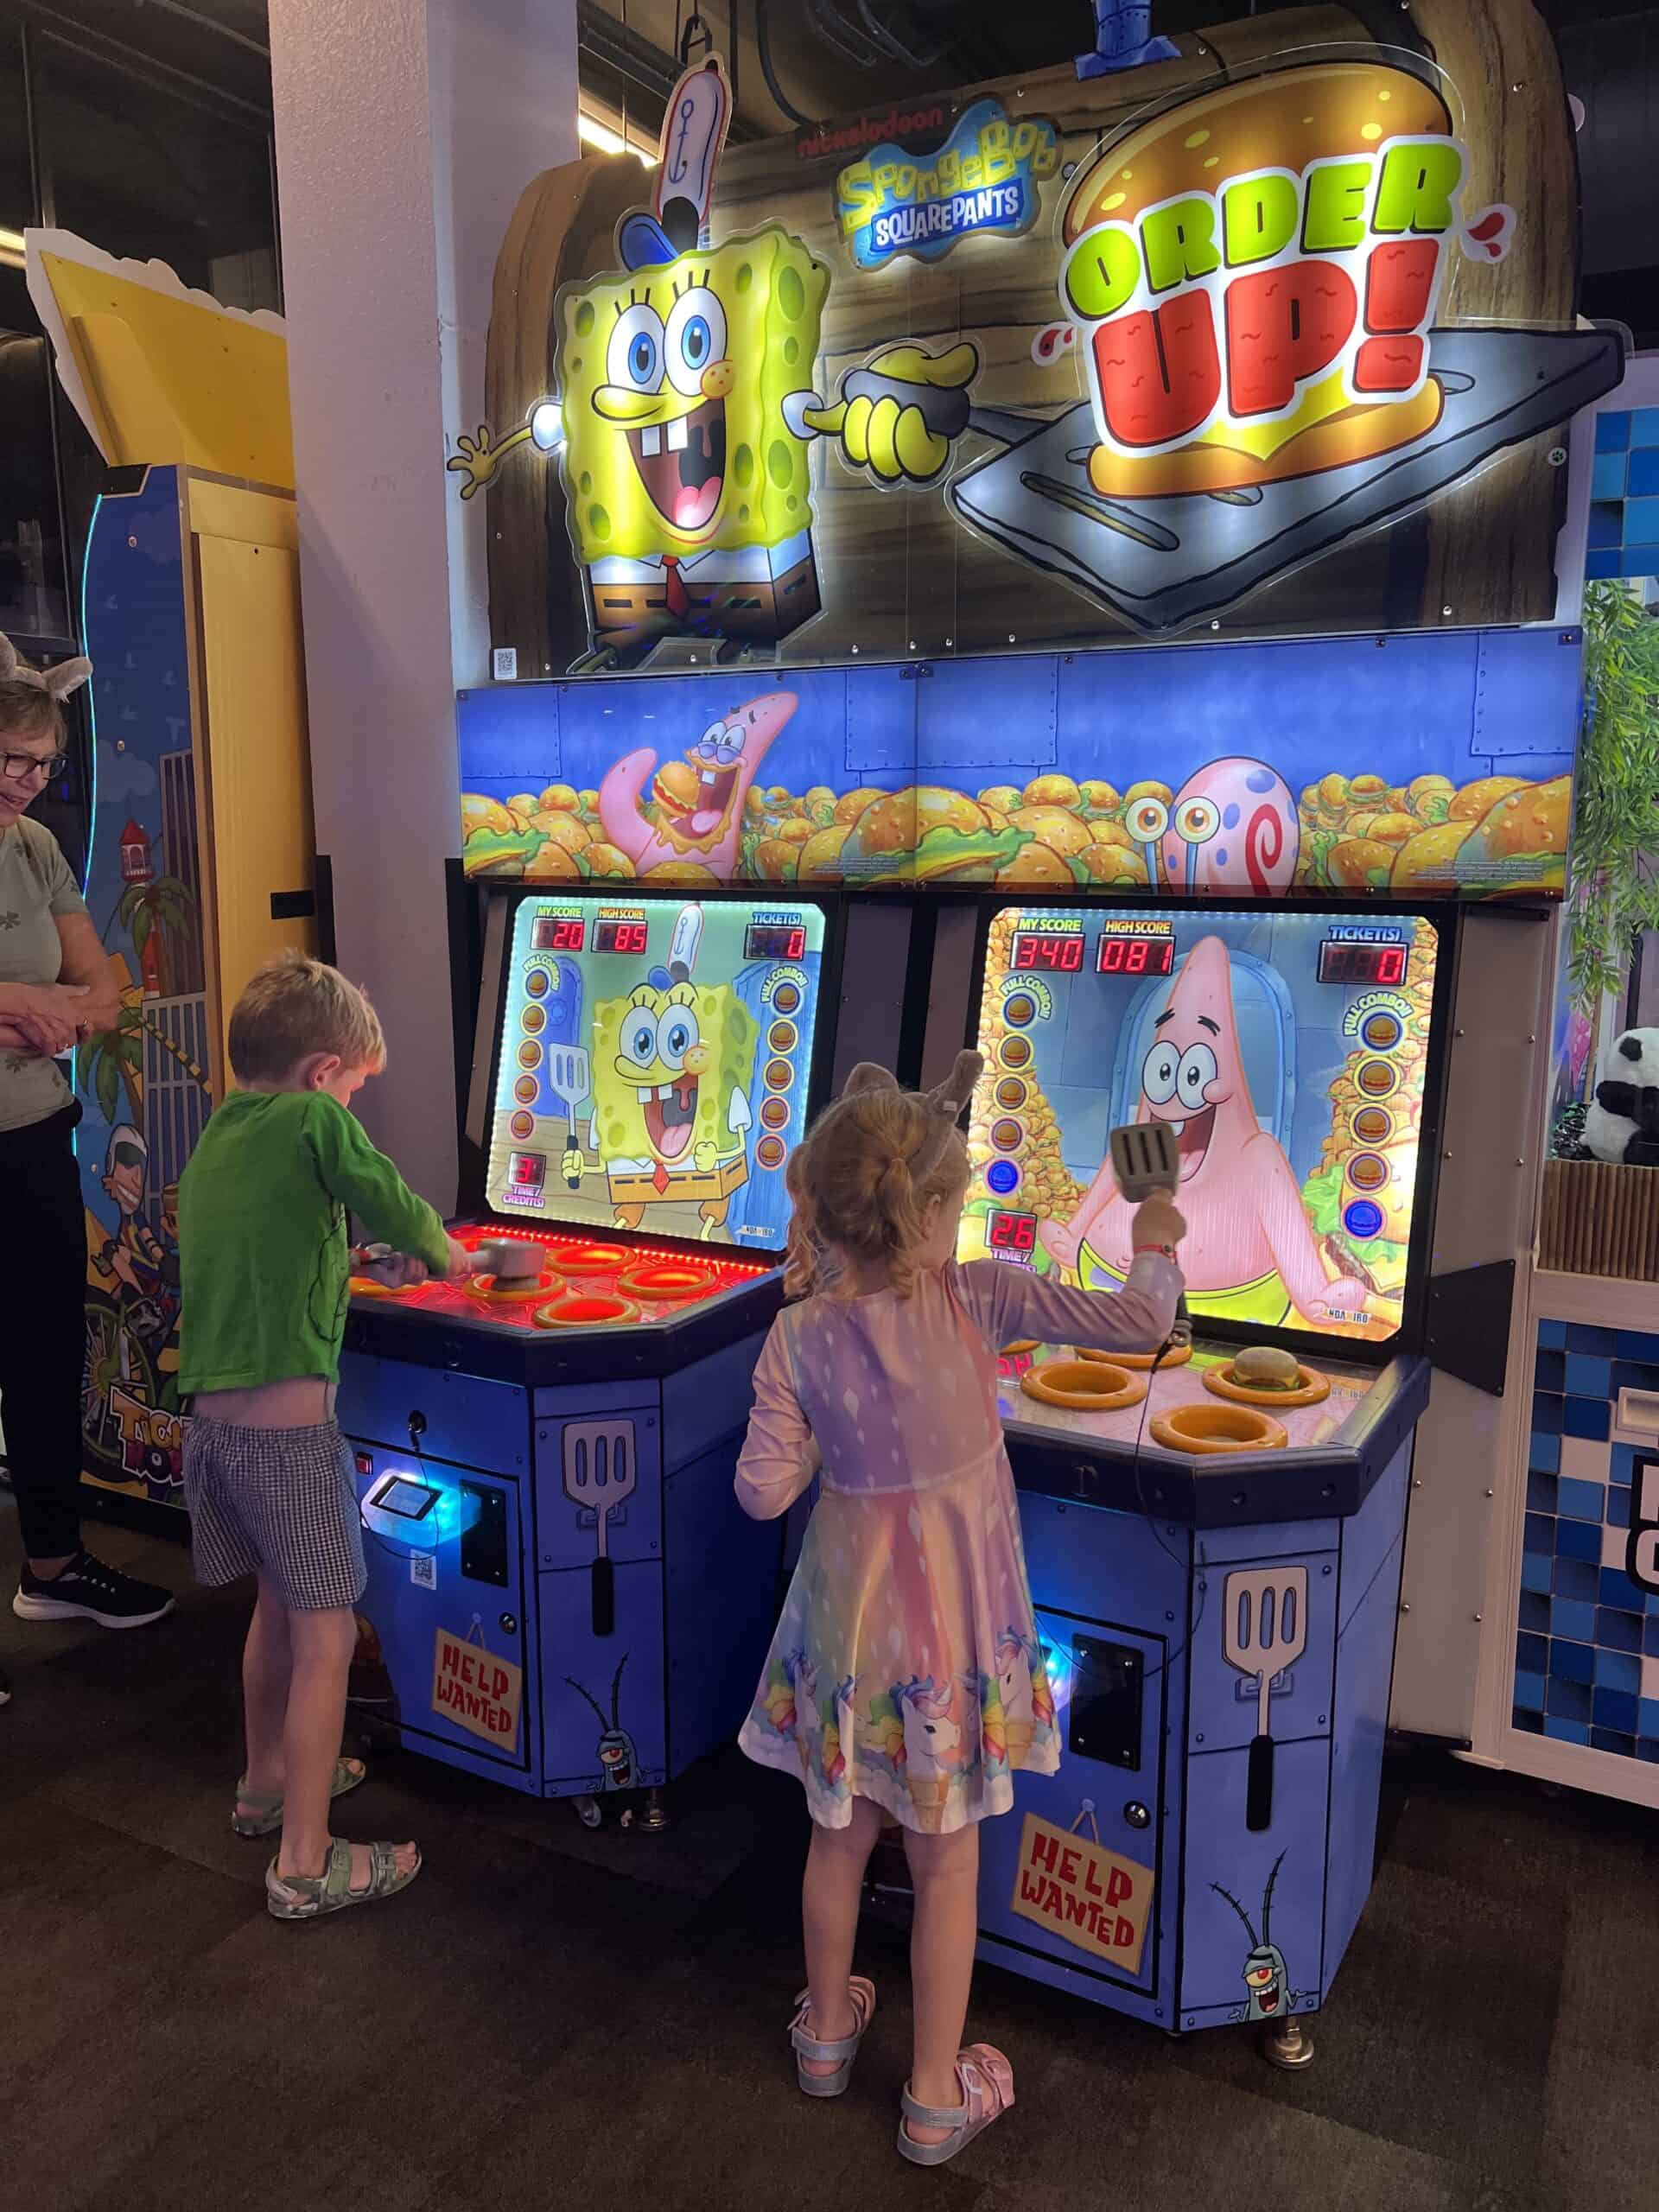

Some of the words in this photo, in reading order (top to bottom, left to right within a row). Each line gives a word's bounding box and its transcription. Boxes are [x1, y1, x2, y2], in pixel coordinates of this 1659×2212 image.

[875, 187, 1019, 246] SQUAREPANTS
[1066, 143, 1461, 321] ORDER
[1092, 238, 1439, 448] UP!
[537, 906, 551, 917] MY
[552, 907, 583, 918] SCORE
[599, 908, 619, 918] HIGH
[620, 909, 645, 919] SCORE
[1019, 918, 1039, 931] MY
[1039, 919, 1082, 931] SCORE
[1106, 920, 1133, 933] HIGH
[1135, 921, 1171, 934] SCORE
[553, 924, 584, 947] 20
[1018, 938, 1082, 969] 340
[1377, 950, 1404, 982] 0
[1000, 975, 1024, 996] FULL
[1343, 1005, 1363, 1036] FULL
[992, 1214, 1034, 1249] 26
[442, 1643, 510, 1700] HELP
[437, 1675, 512, 1732] WANTED
[1031, 1832, 1133, 1908] HELP
[1021, 1870, 1135, 1947] WANTED
